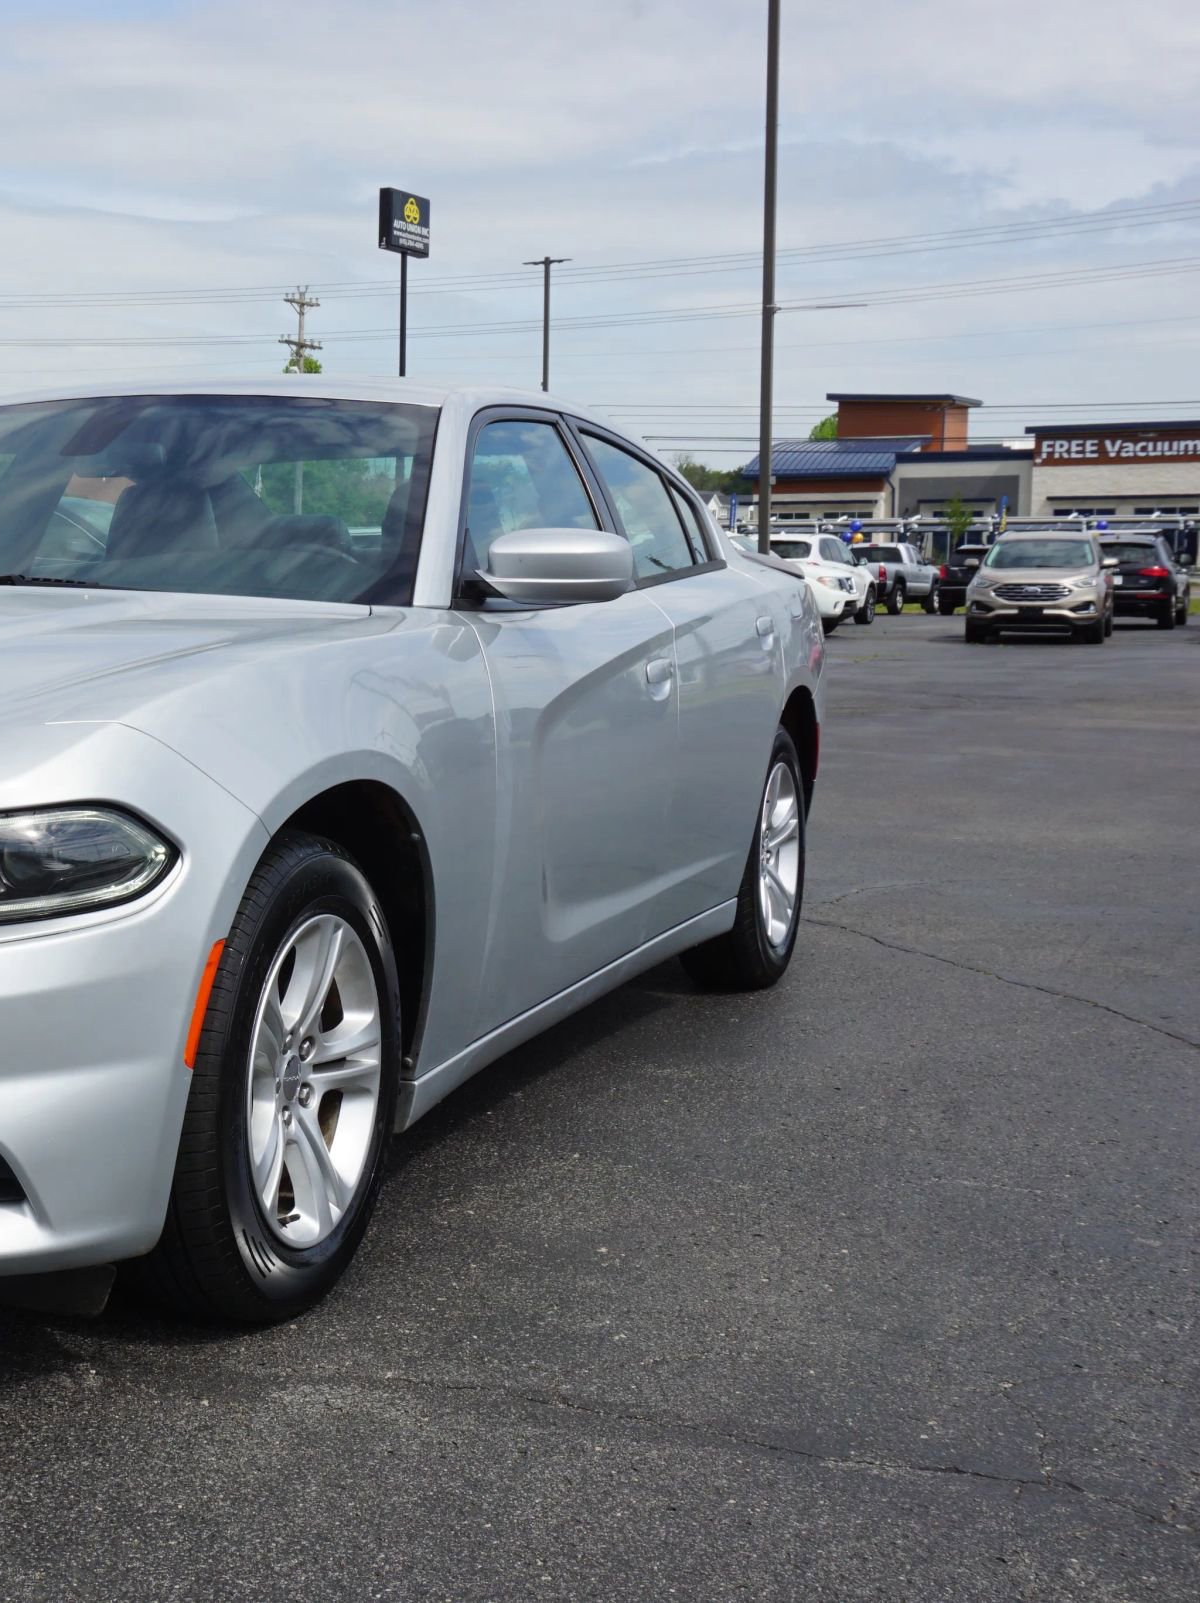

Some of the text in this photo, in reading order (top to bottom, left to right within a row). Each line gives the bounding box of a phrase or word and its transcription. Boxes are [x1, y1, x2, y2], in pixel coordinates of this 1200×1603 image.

[393, 219, 407, 231] AUTO
[407, 222, 422, 235] UNION
[1041, 439, 1200, 459] FREE Vacuum
